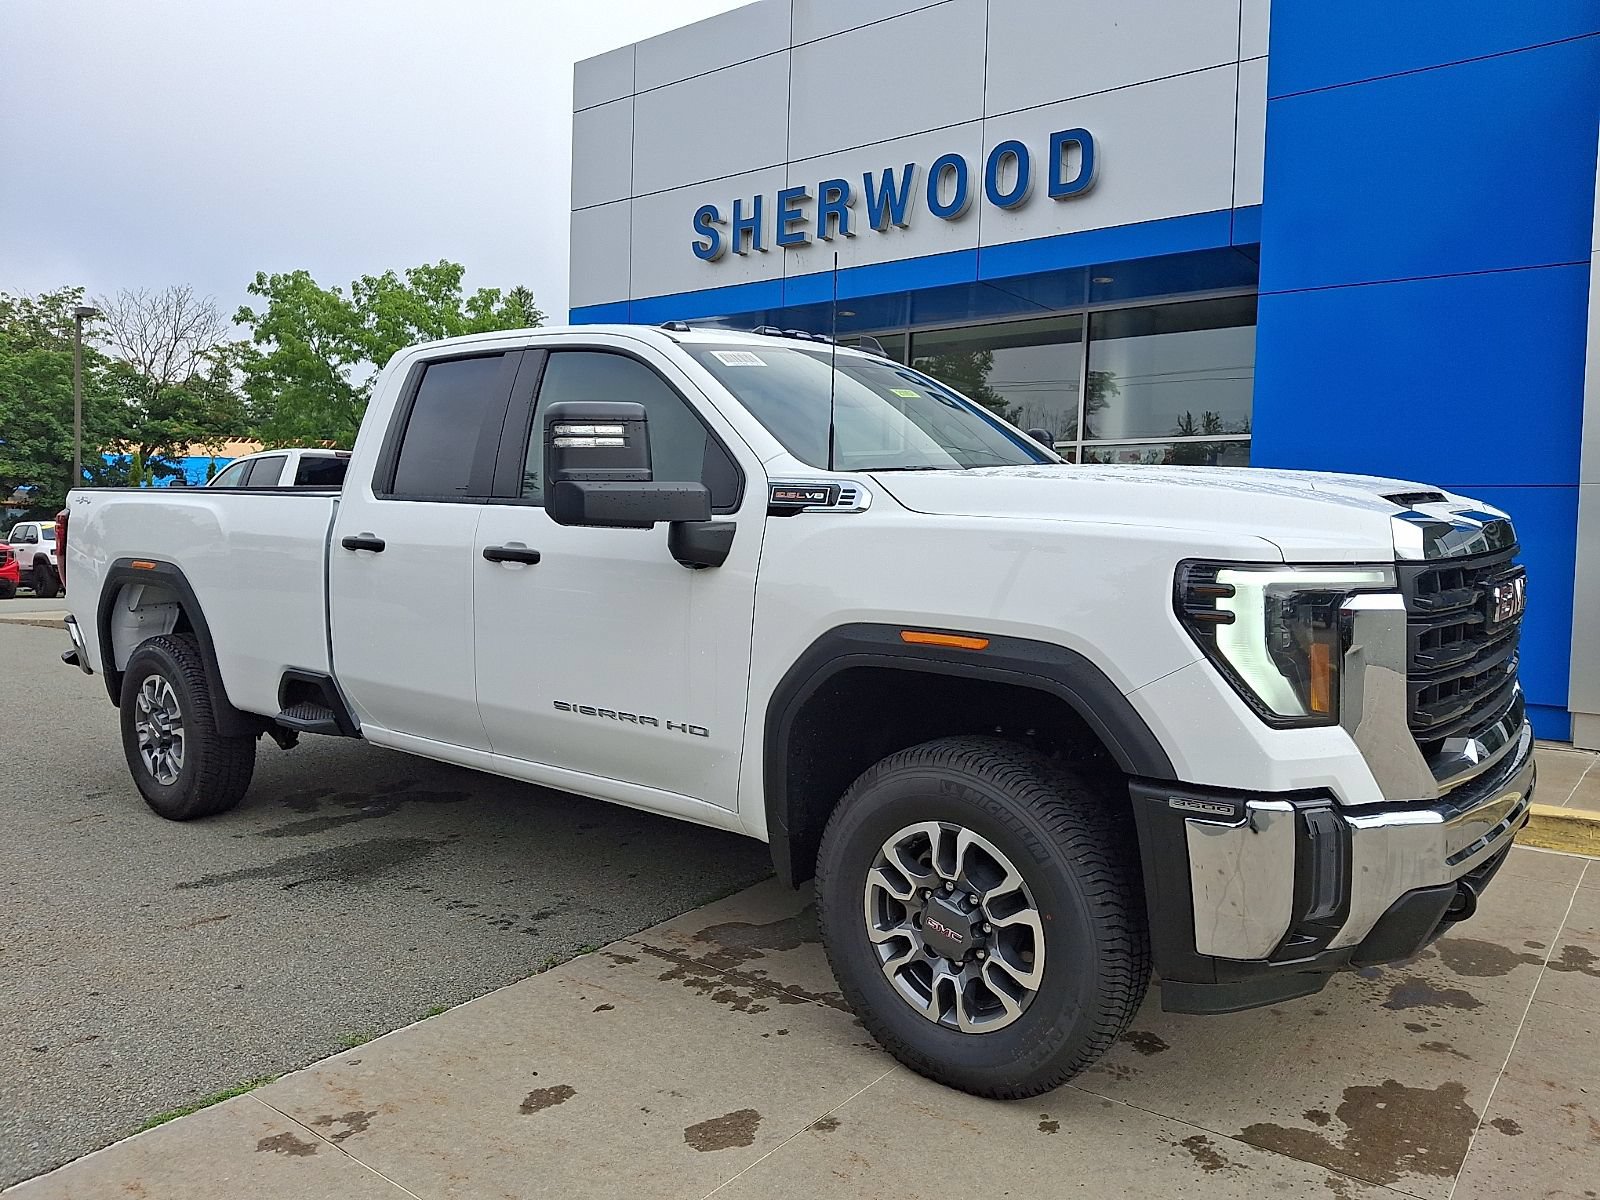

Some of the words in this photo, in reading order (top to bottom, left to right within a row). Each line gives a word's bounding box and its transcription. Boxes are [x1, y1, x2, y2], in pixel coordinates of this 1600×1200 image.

[692, 128, 1097, 261] SHERWOOD
[553, 700, 660, 728] SIERRA
[666, 720, 710, 737] HD
[926, 916, 963, 944] GMC
